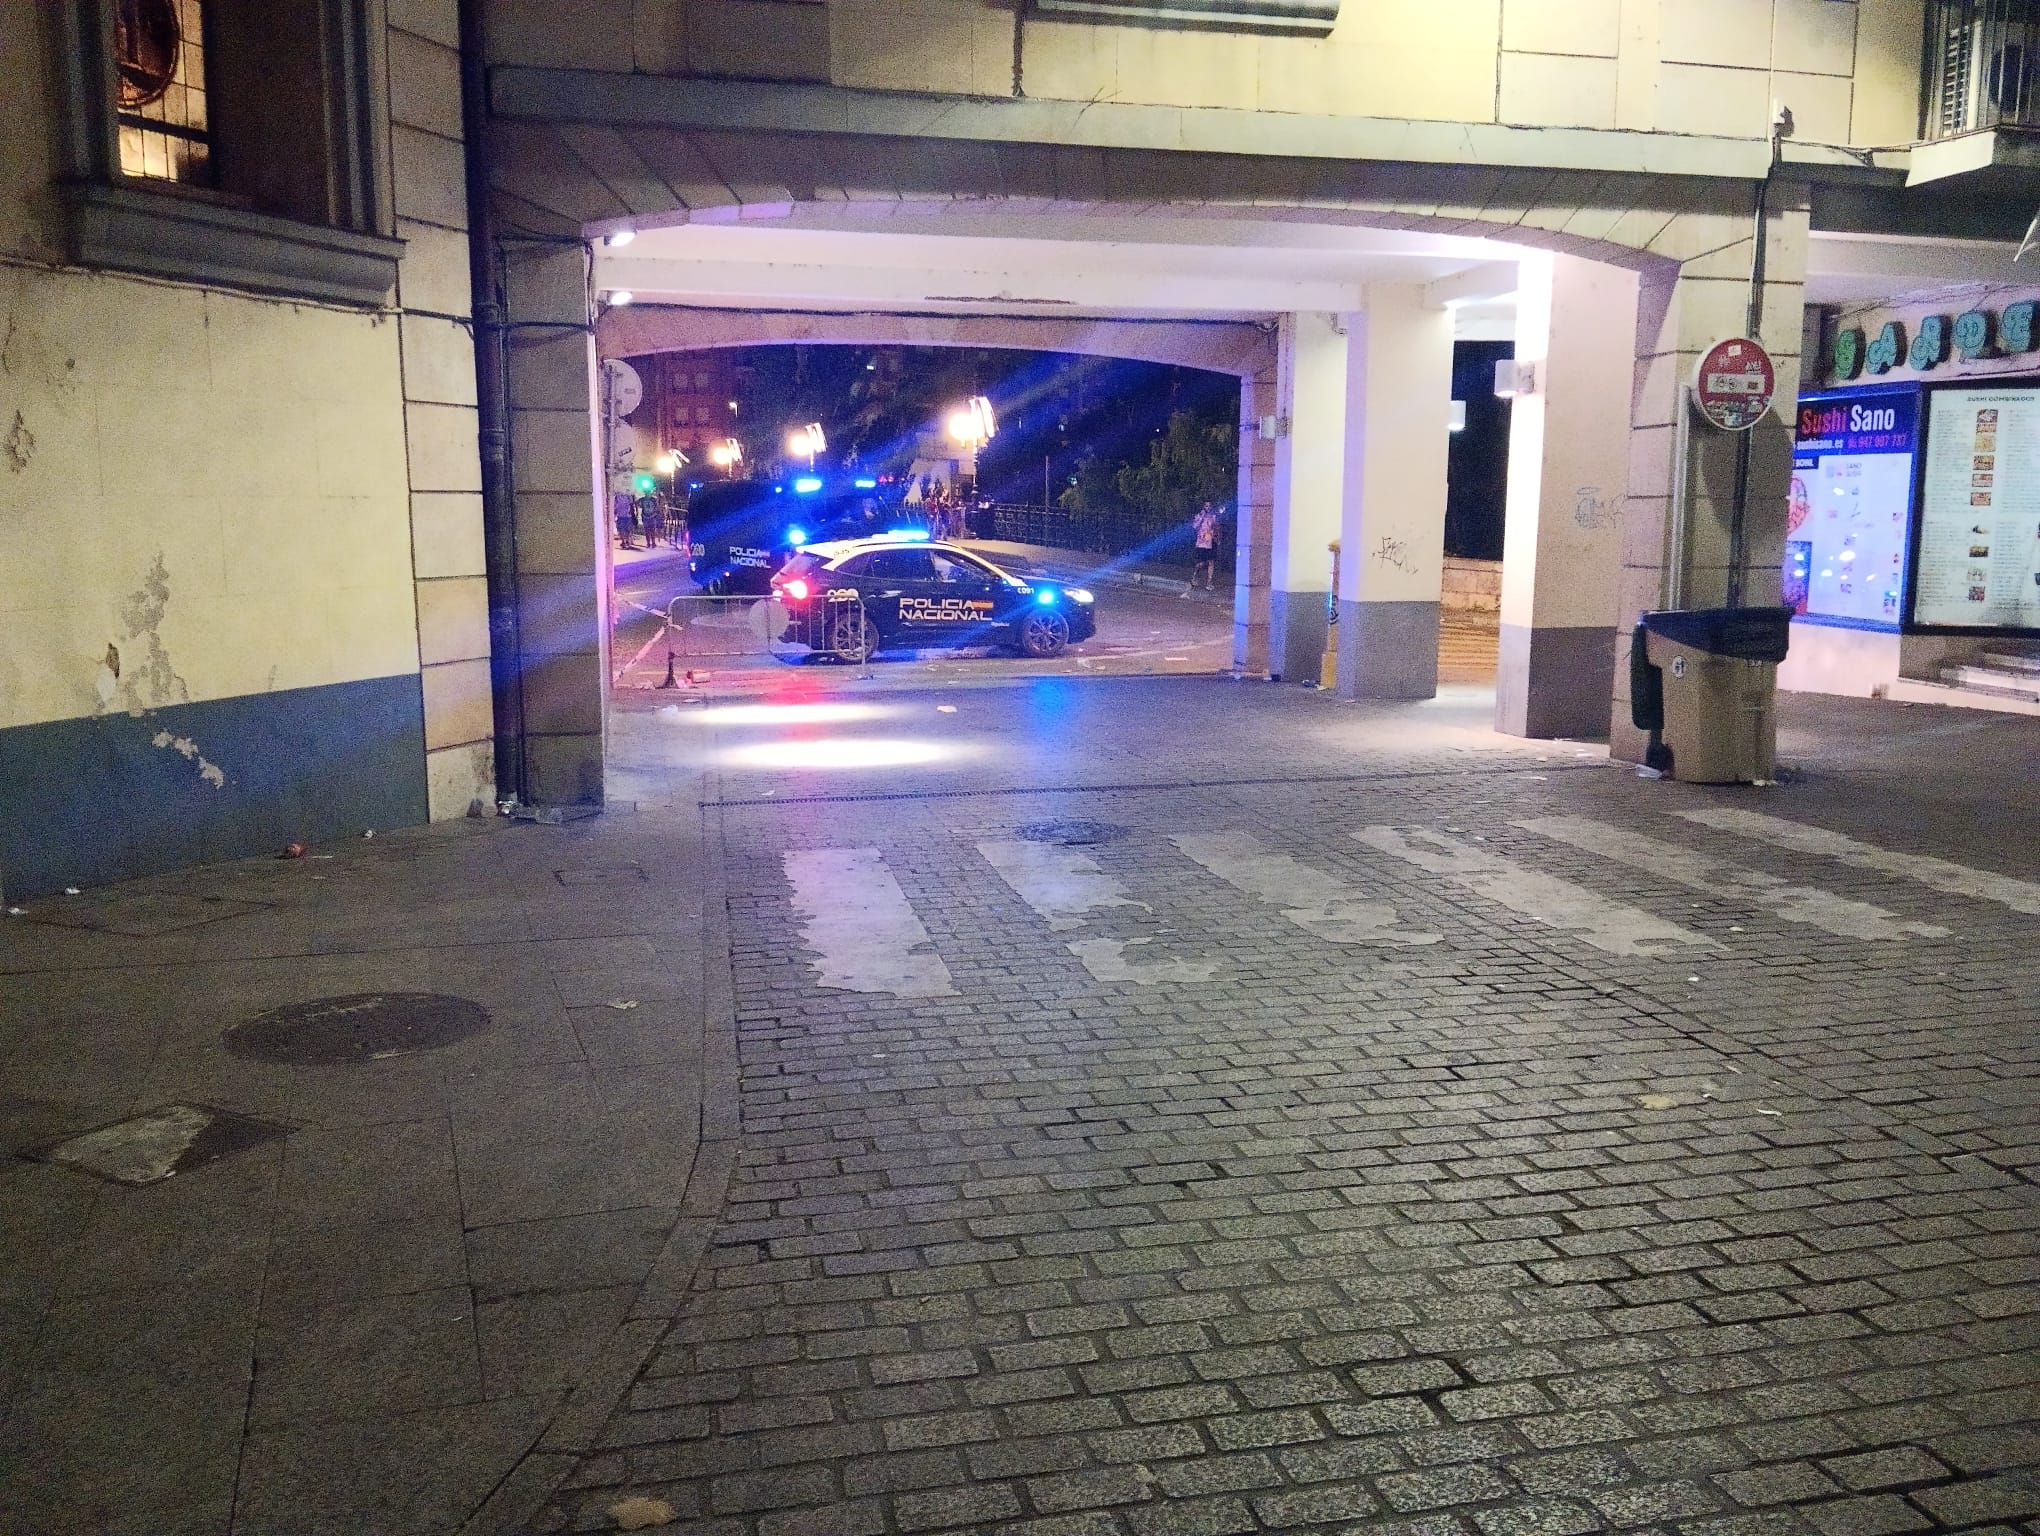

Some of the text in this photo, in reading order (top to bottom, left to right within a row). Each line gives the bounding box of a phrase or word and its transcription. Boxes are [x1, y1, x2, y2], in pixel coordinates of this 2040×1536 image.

[1801, 404, 1895, 435] Sushi Sano
[729, 546, 762, 558] POLICIA
[730, 556, 772, 569] NACIONAL
[899, 597, 975, 610] POLICIA
[898, 609, 993, 621] NACIONAL
